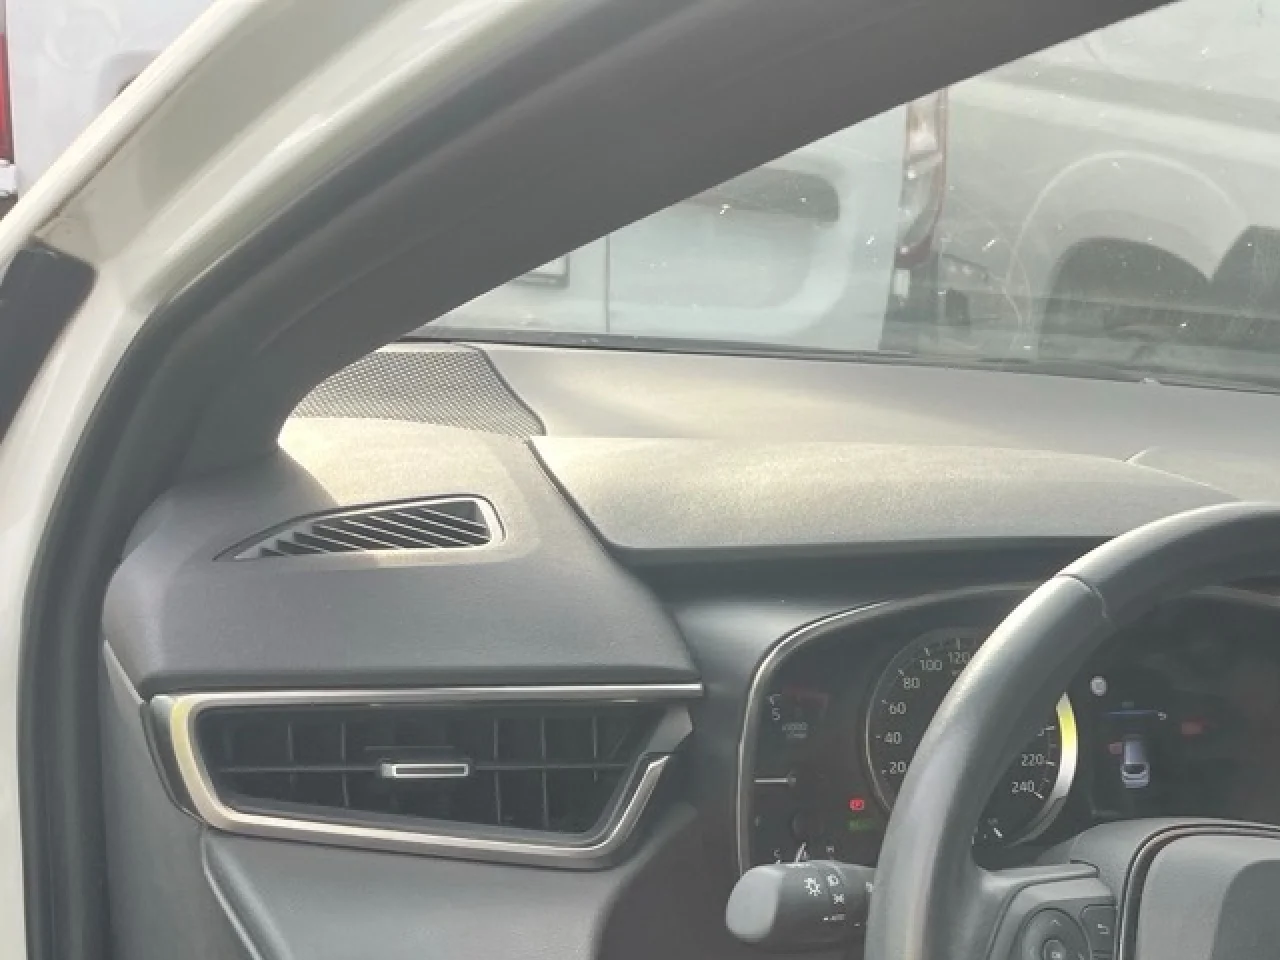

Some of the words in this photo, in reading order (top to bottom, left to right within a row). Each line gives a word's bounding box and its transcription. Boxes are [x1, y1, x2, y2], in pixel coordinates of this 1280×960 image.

[919, 659, 943, 671] 100
[903, 677, 921, 690] 80
[888, 701, 907, 715] 60
[883, 731, 903, 745] 40
[1021, 754, 1044, 767] 220
[889, 761, 907, 775] 20
[1011, 779, 1035, 793] 240
